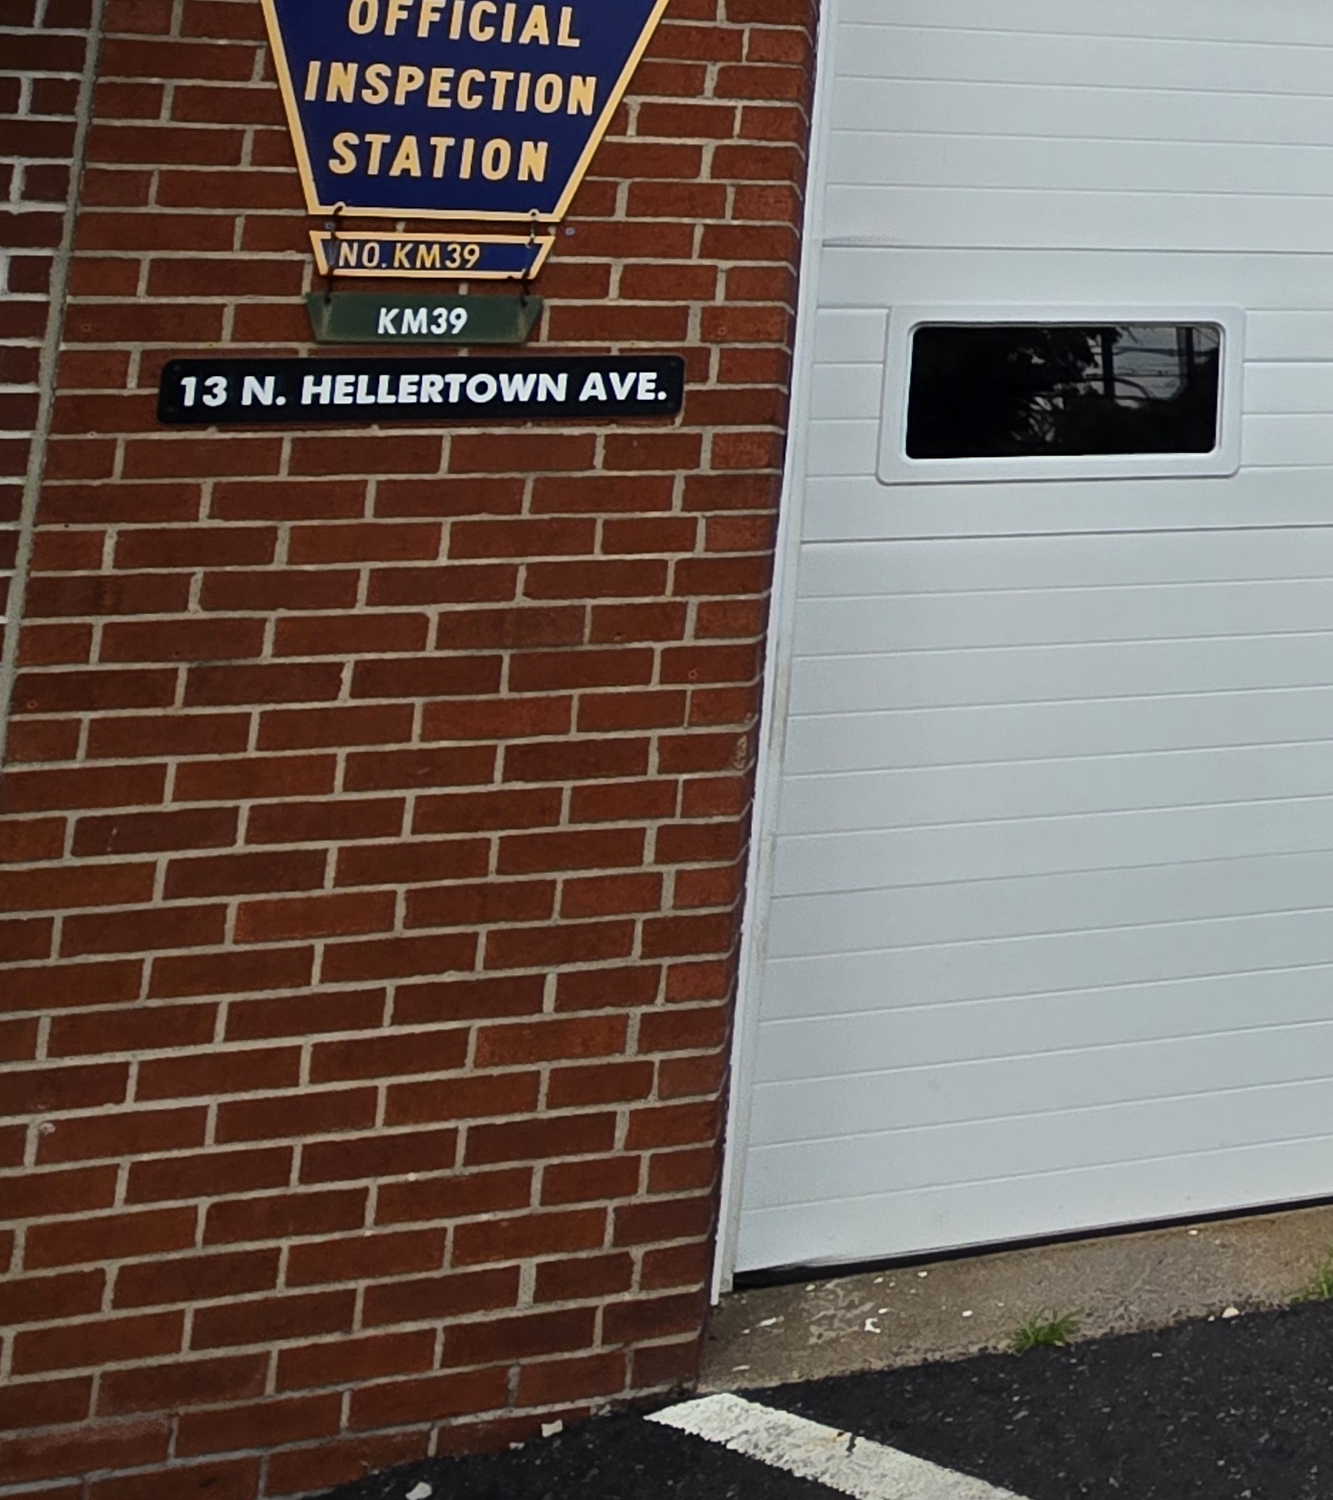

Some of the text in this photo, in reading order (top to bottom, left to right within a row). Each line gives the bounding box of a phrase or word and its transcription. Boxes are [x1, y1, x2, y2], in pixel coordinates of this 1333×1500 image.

[304, 60, 597, 116] INSPECTION
[328, 132, 548, 183] STATION
[377, 307, 468, 335] KM39
[180, 371, 668, 407] 13 N. HELLERTOWN AVE.
